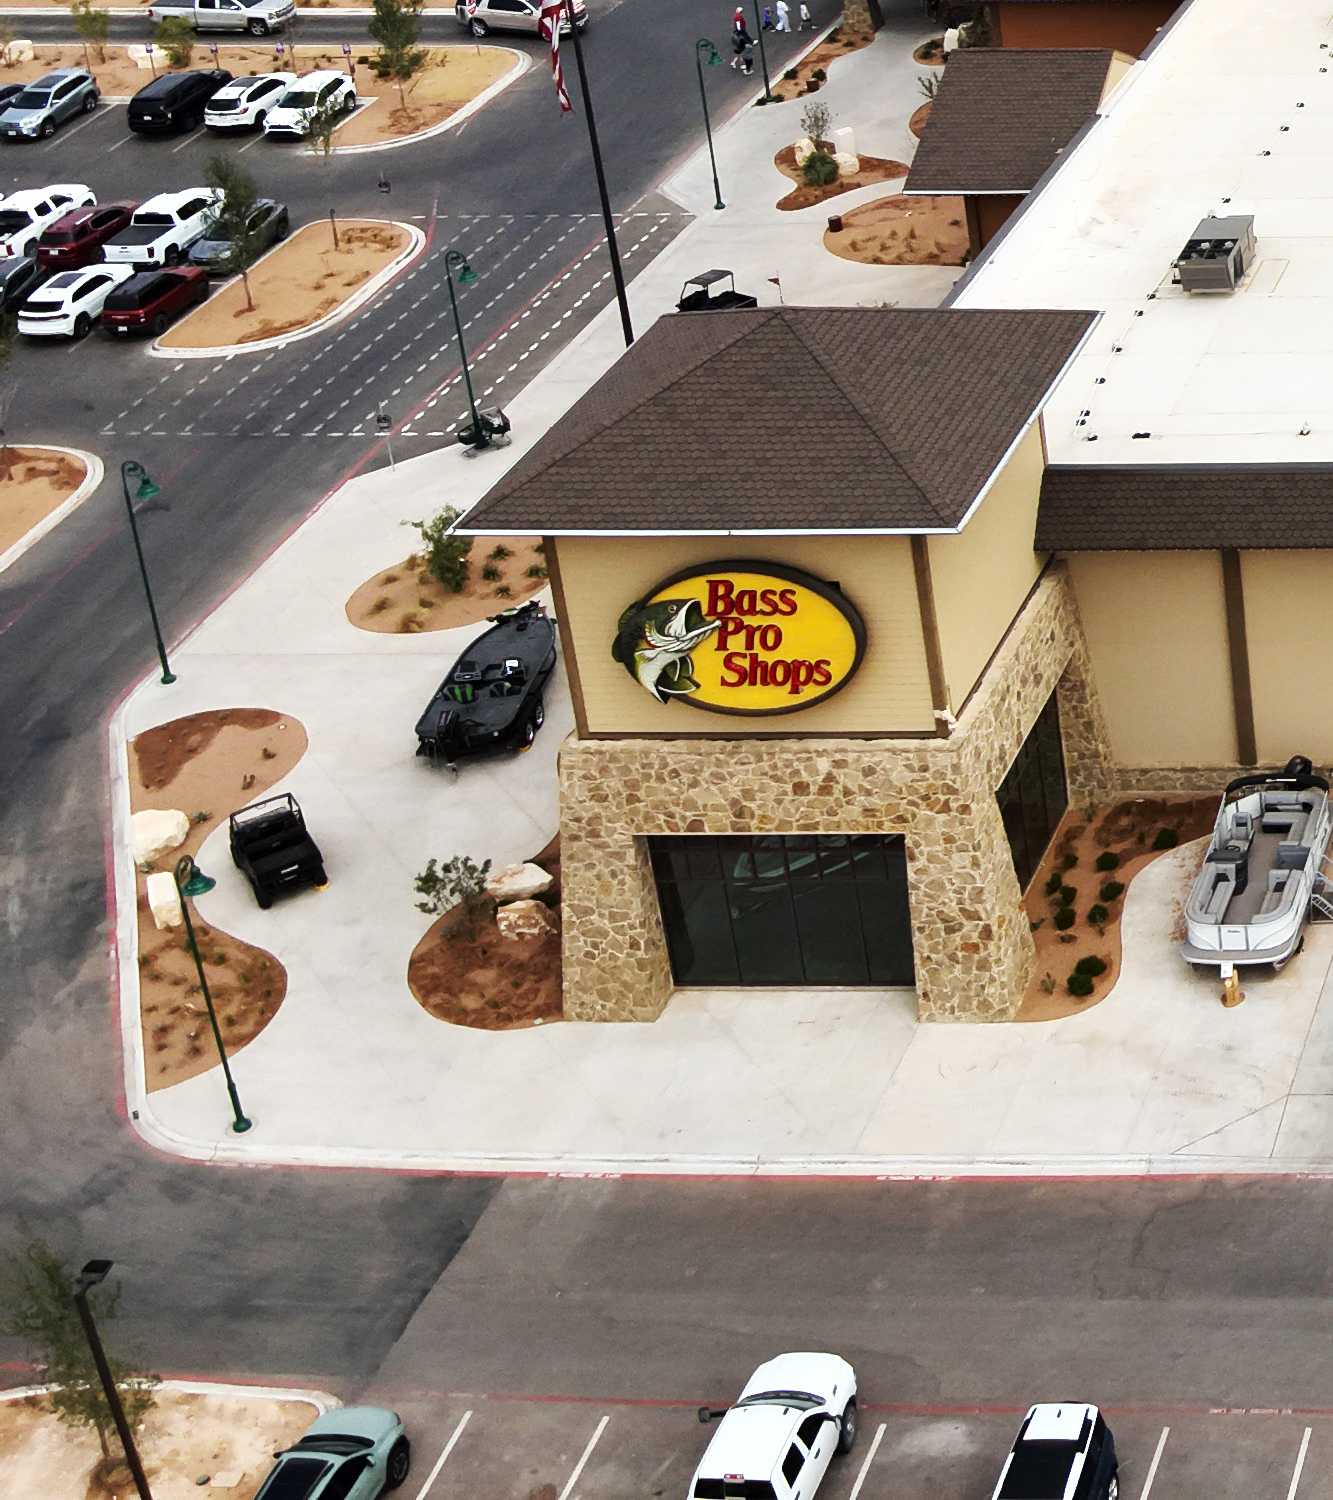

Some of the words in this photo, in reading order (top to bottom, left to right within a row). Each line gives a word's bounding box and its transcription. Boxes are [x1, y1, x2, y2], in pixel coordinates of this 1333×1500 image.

[705, 580, 797, 617] Bass
[715, 617, 782, 651] Pro
[720, 652, 832, 695] Shops
